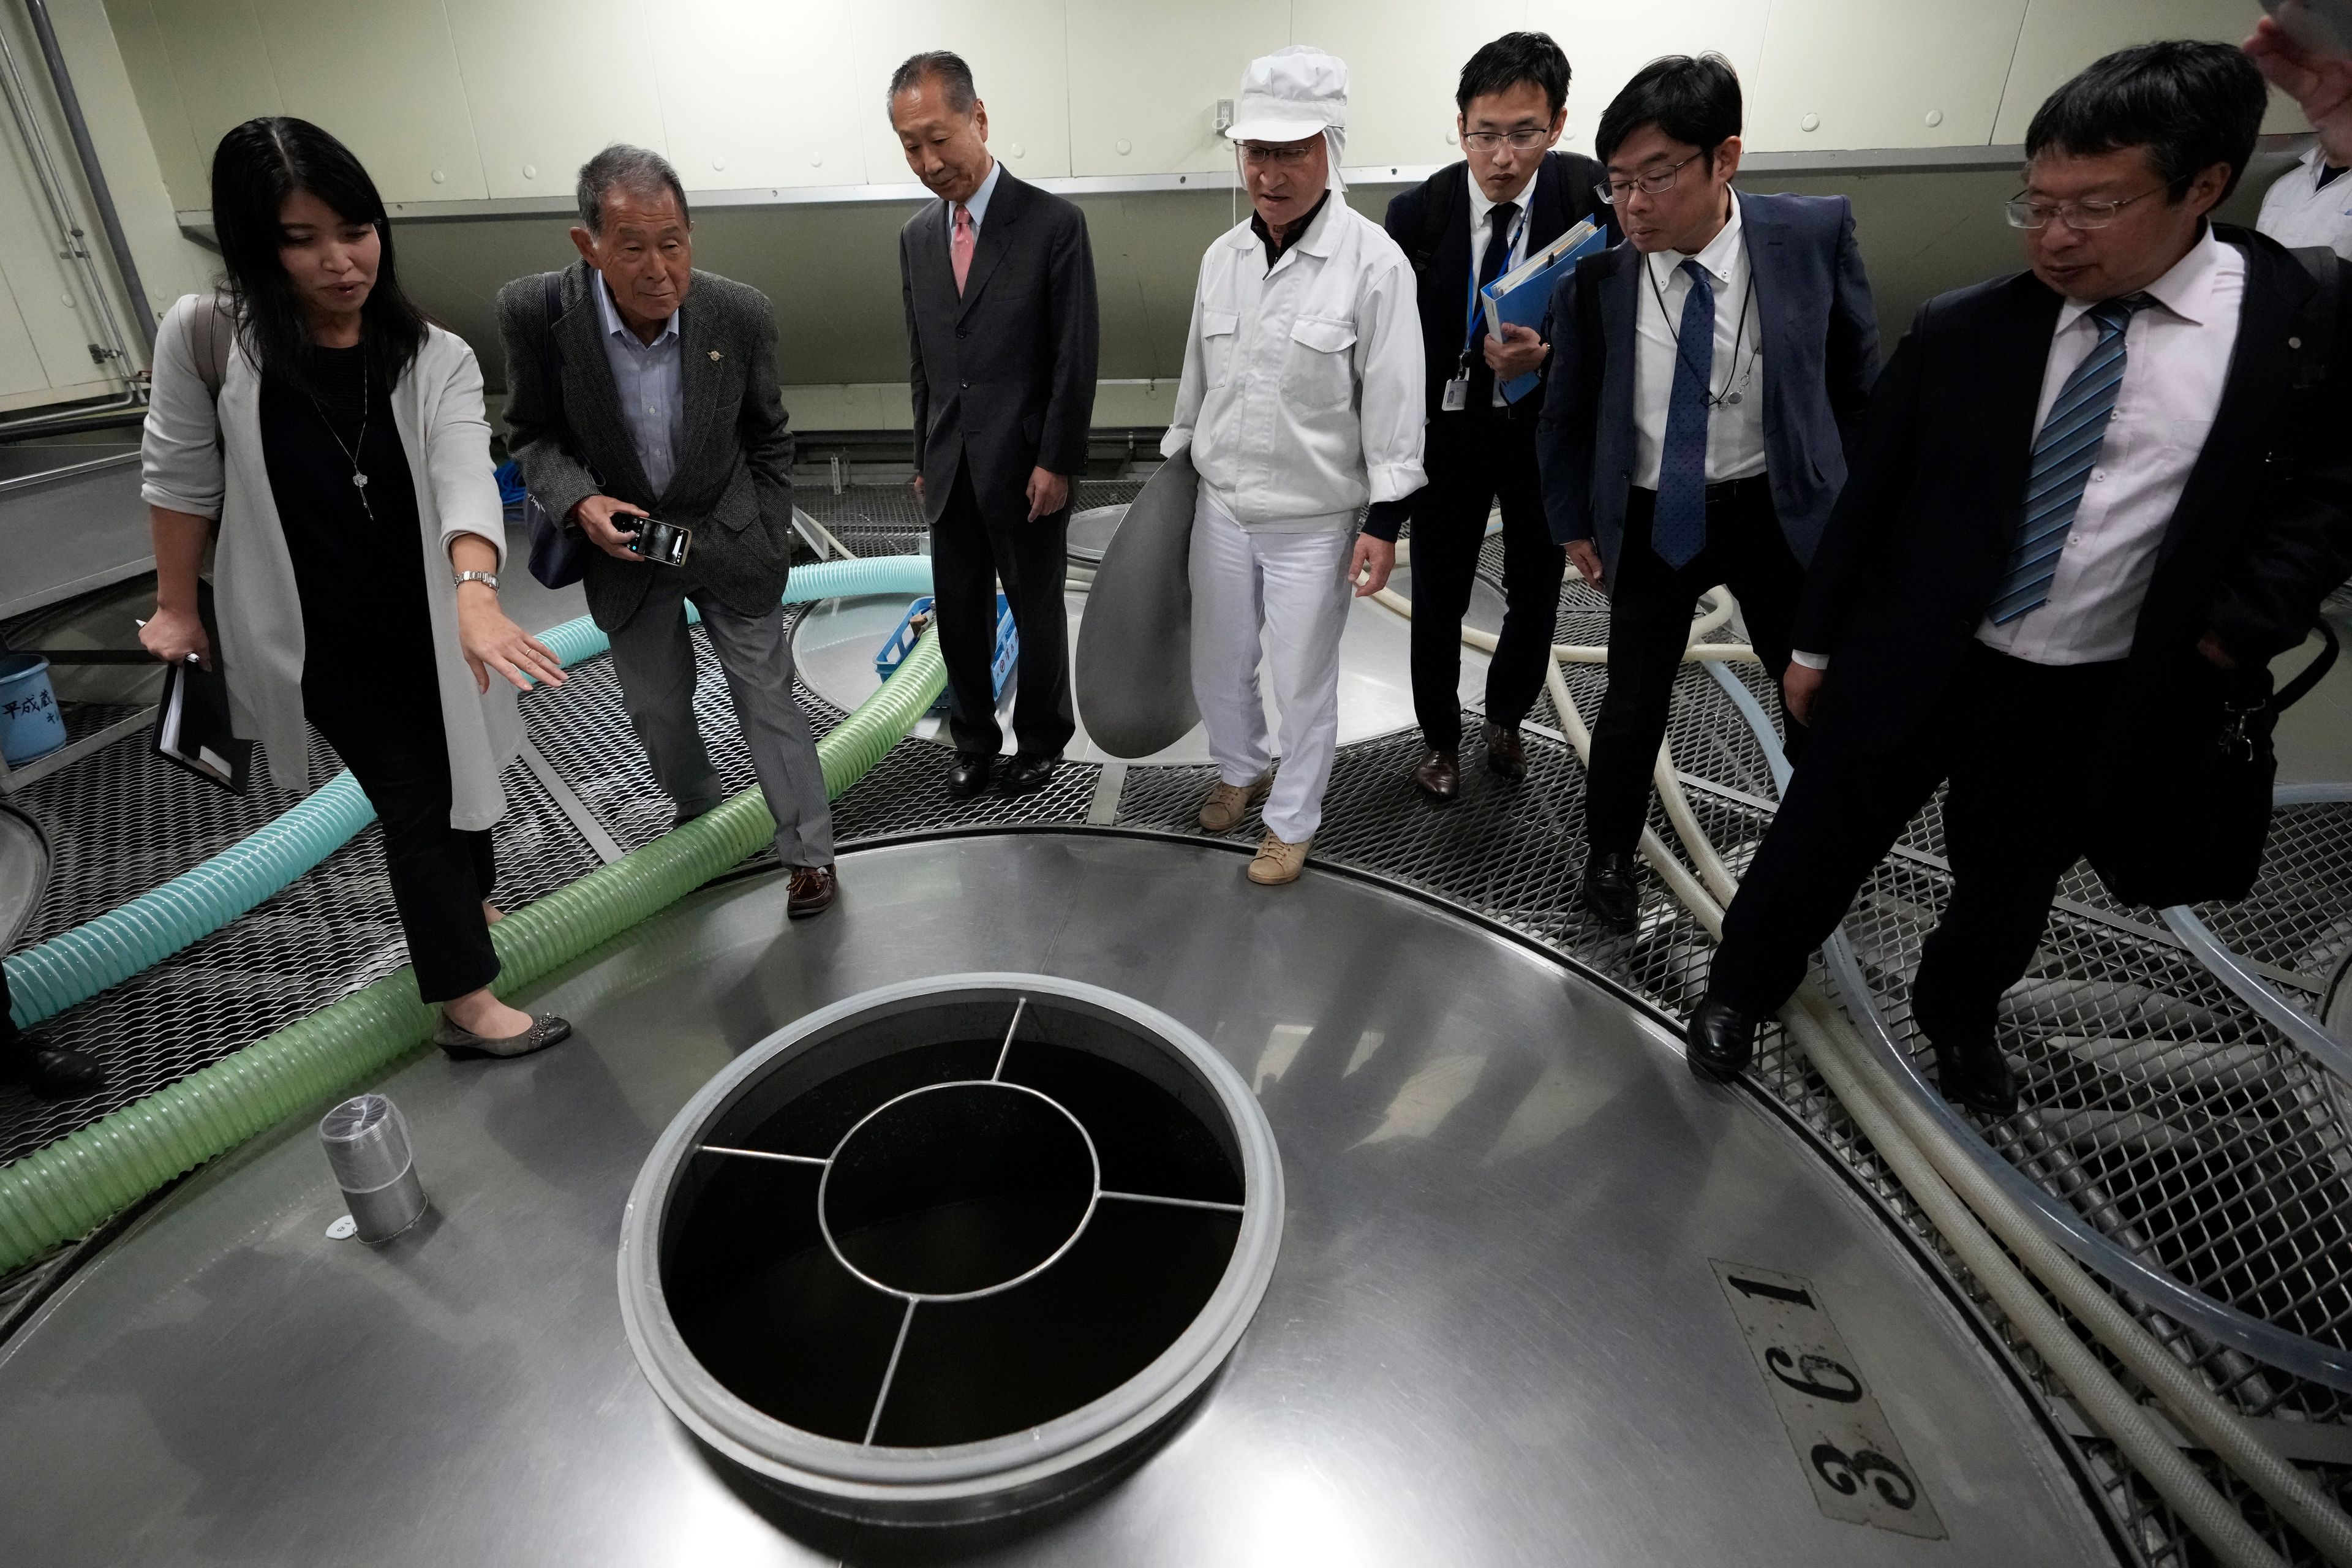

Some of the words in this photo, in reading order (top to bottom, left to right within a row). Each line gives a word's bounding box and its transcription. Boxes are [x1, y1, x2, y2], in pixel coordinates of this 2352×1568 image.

[2, 688, 53, 720] 平成蔵
[1728, 1275, 1917, 1510] 361
